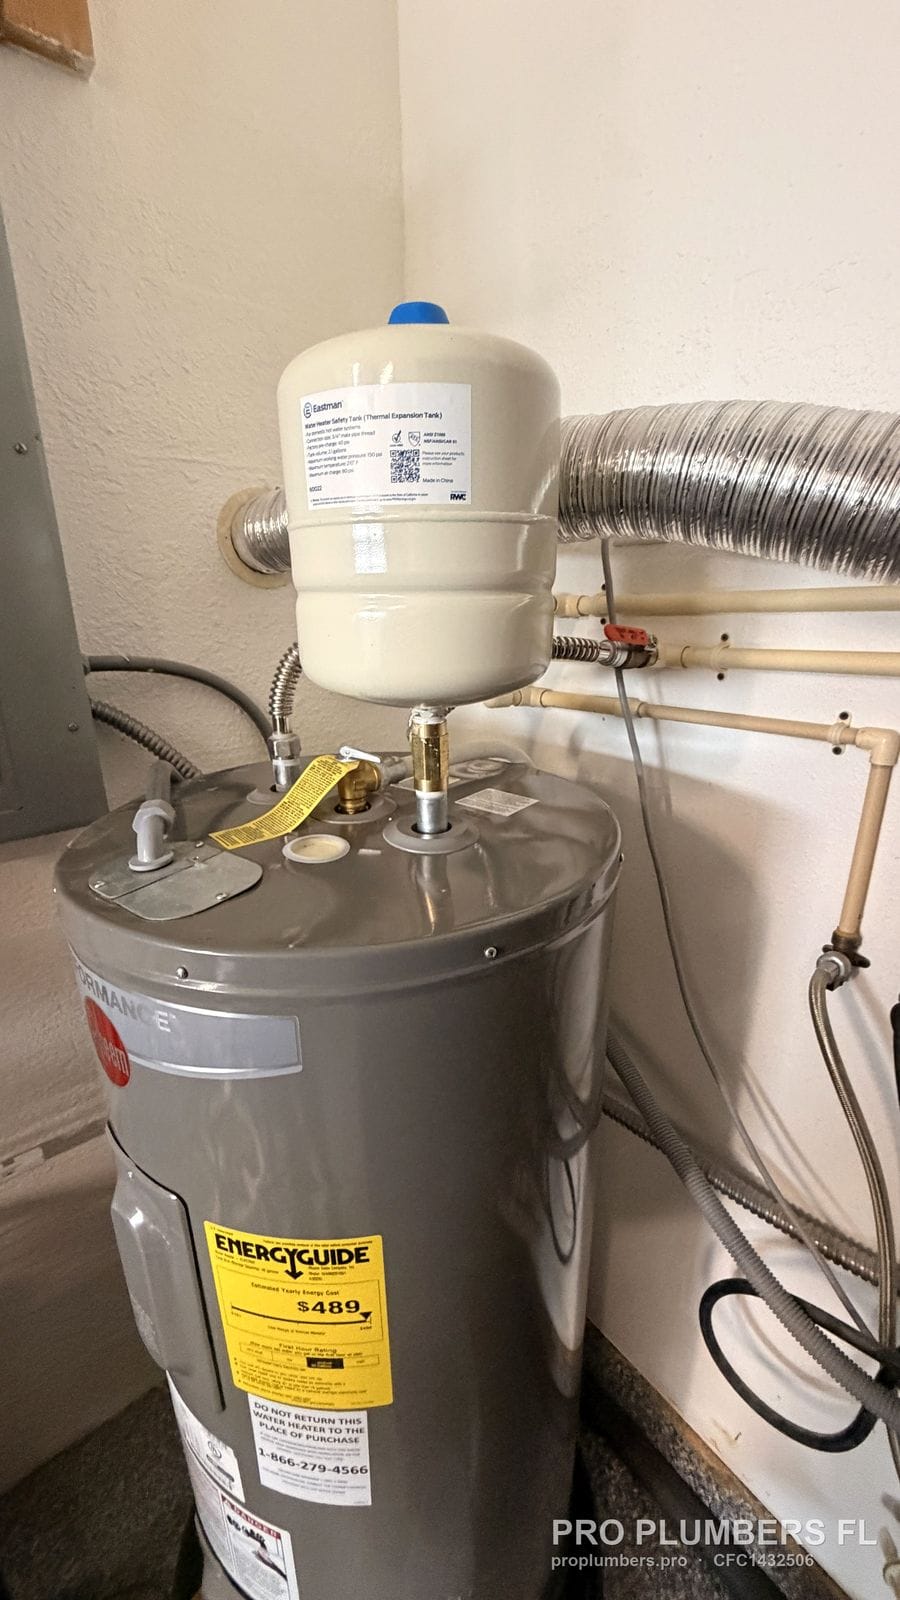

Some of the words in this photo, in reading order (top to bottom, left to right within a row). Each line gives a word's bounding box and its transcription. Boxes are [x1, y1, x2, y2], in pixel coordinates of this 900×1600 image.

[313, 401, 343, 413] Eastman
[363, 413, 390, 422] (Thermal
[391, 412, 424, 420] Expansion
[424, 412, 443, 420] Tank)
[450, 493, 467, 501] RWC
[215, 1233, 370, 1270] ENERGYGUIDE
[282, 1288, 300, 1296] Yearly
[302, 1289, 324, 1297] Energy
[297, 1300, 360, 1315] $489
[313, 1346, 337, 1354] Rating
[254, 1402, 269, 1412] DO
[271, 1407, 292, 1419] NOT
[294, 1414, 336, 1425] RETURN
[338, 1418, 362, 1426] THIS
[252, 1410, 286, 1426] WATER
[288, 1422, 326, 1433] HEATER
[329, 1427, 342, 1435] TO
[259, 1421, 288, 1436] PLACE
[289, 1431, 303, 1440] OF
[305, 1434, 360, 1444] PURCHASE
[258, 1447, 369, 1475] 1-866-279-4566
